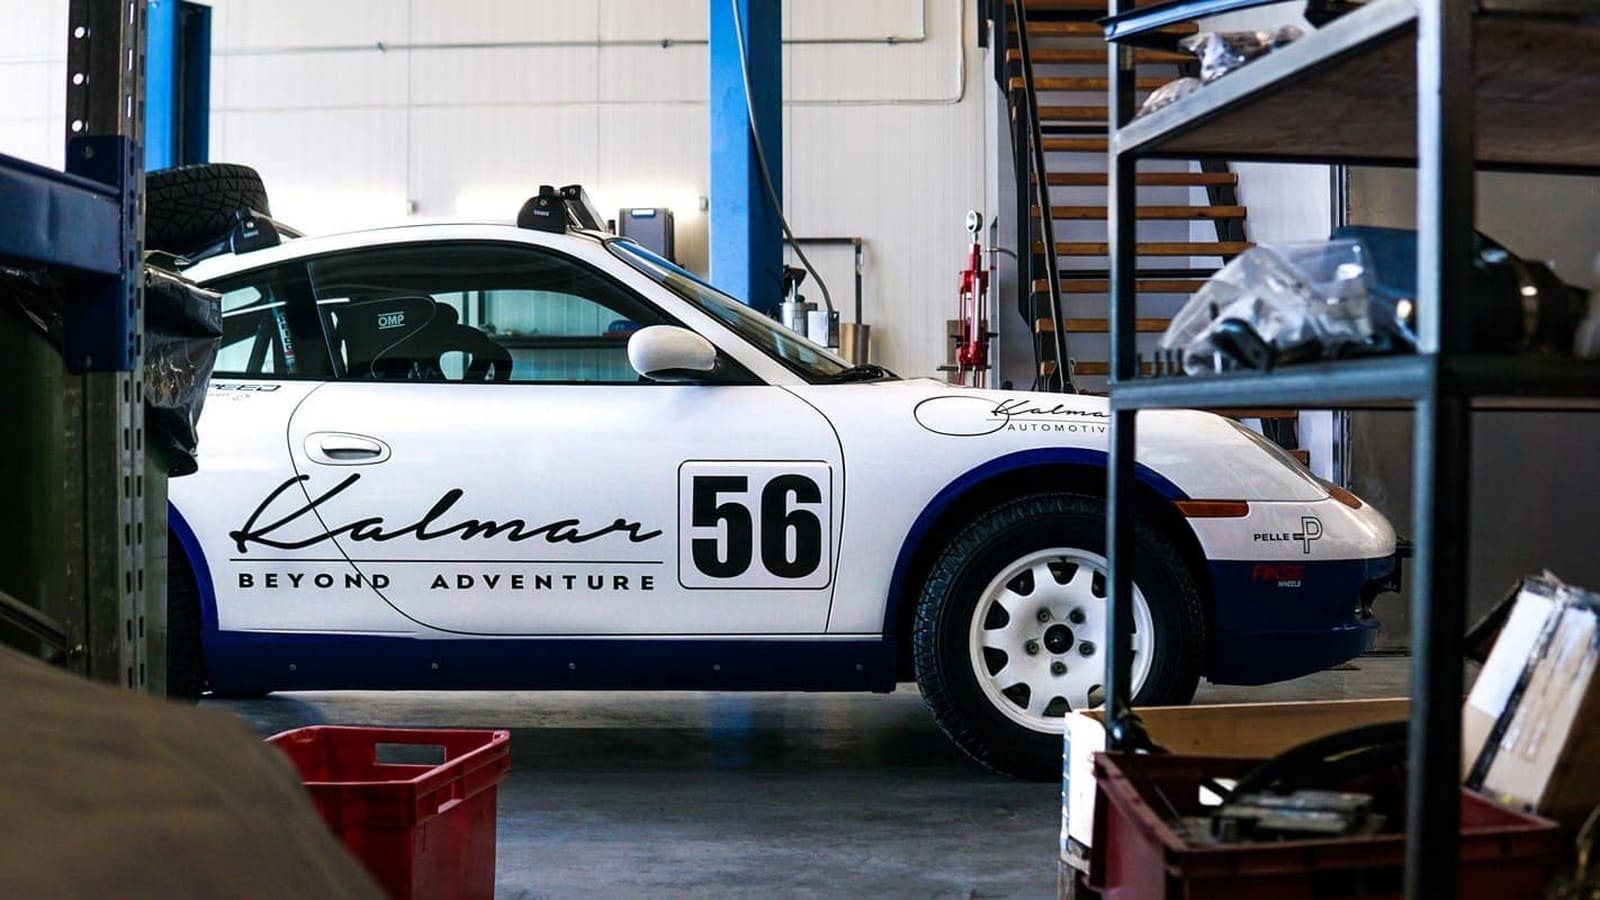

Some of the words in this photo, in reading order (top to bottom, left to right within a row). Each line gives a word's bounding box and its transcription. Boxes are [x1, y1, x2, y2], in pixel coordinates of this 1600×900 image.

[378, 314, 405, 327] OMP
[991, 399, 1112, 417] Kalma
[1007, 423, 1106, 433] AUTOMOTIV
[229, 473, 663, 553] Kalmar
[691, 474, 822, 578] 56
[1253, 533, 1290, 541] PELLE
[238, 573, 391, 589] BEYOND
[431, 574, 656, 591] ADVENTURE
